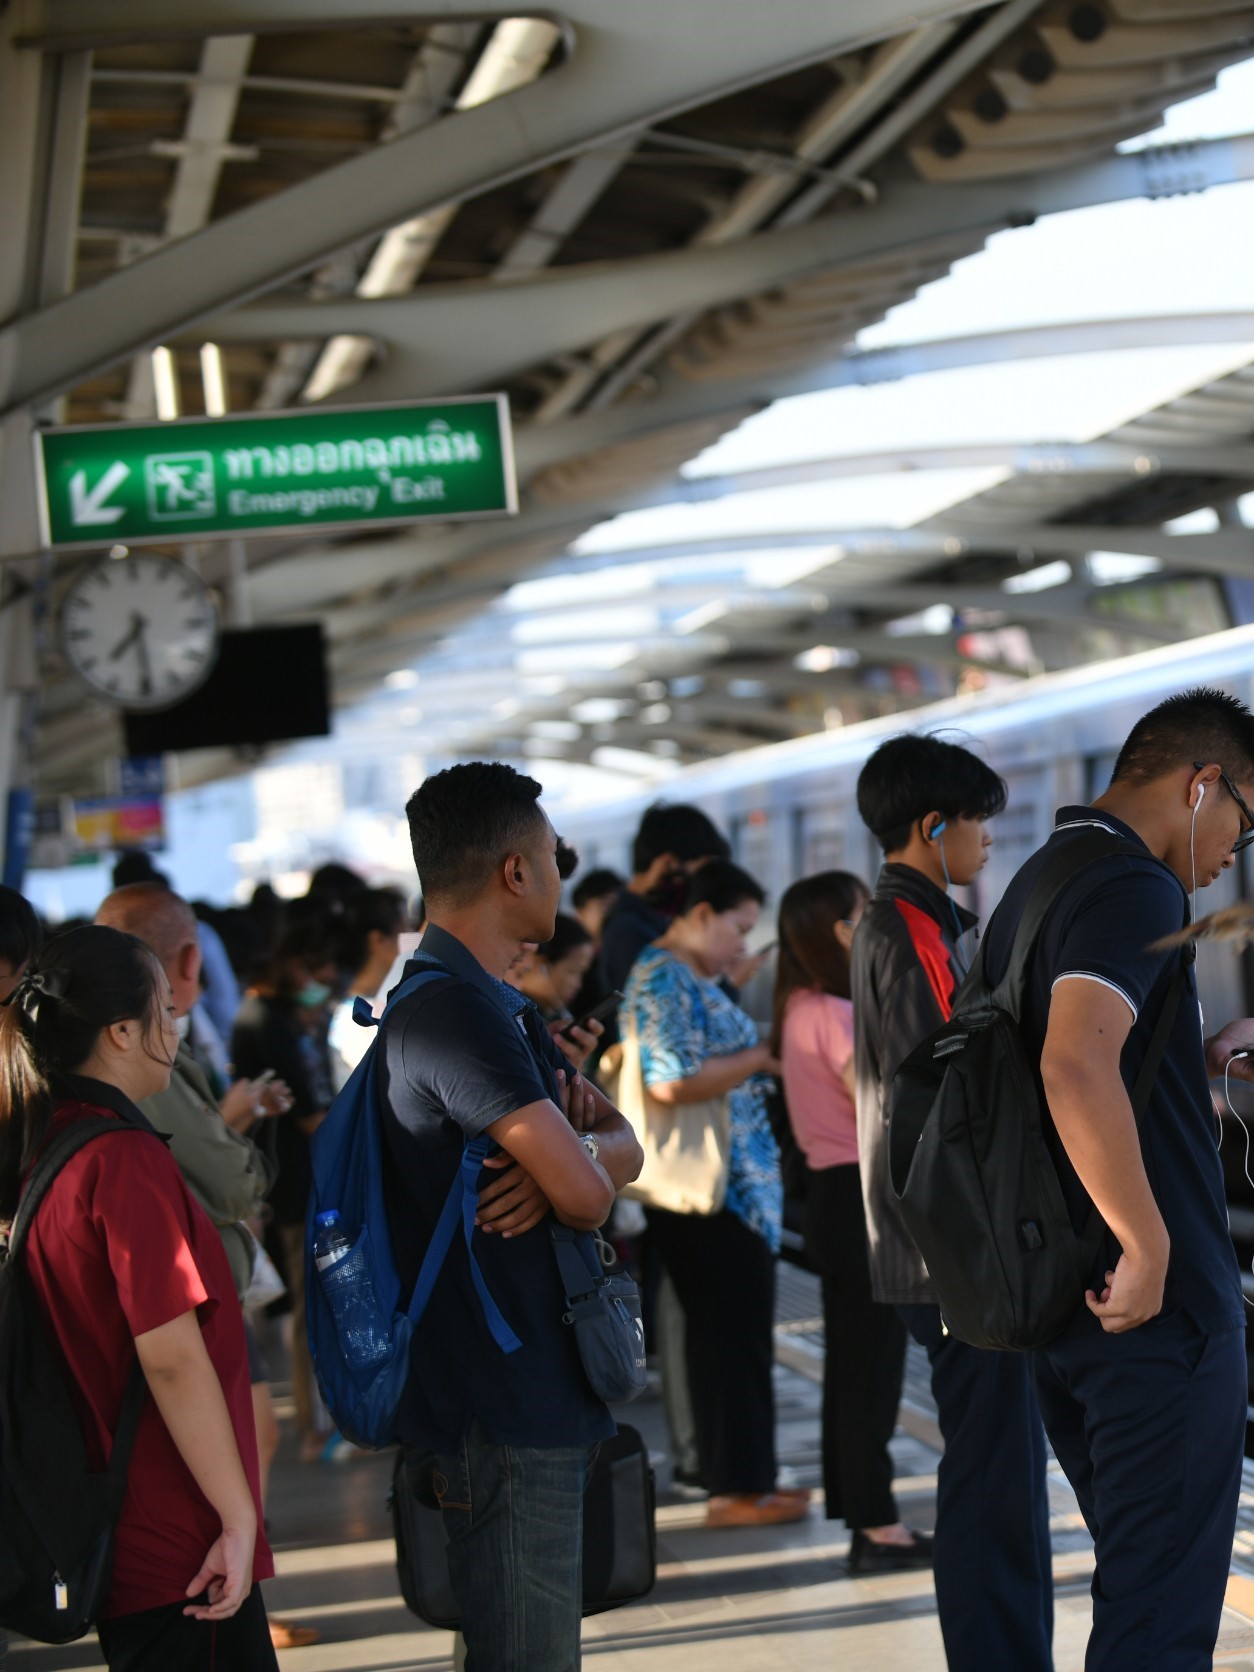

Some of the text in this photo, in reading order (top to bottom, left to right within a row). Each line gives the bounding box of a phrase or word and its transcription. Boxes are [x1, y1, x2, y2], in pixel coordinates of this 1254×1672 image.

[223, 419, 481, 484] ทางออกฉุกเฉิน
[228, 475, 445, 516] Emergency Exit
